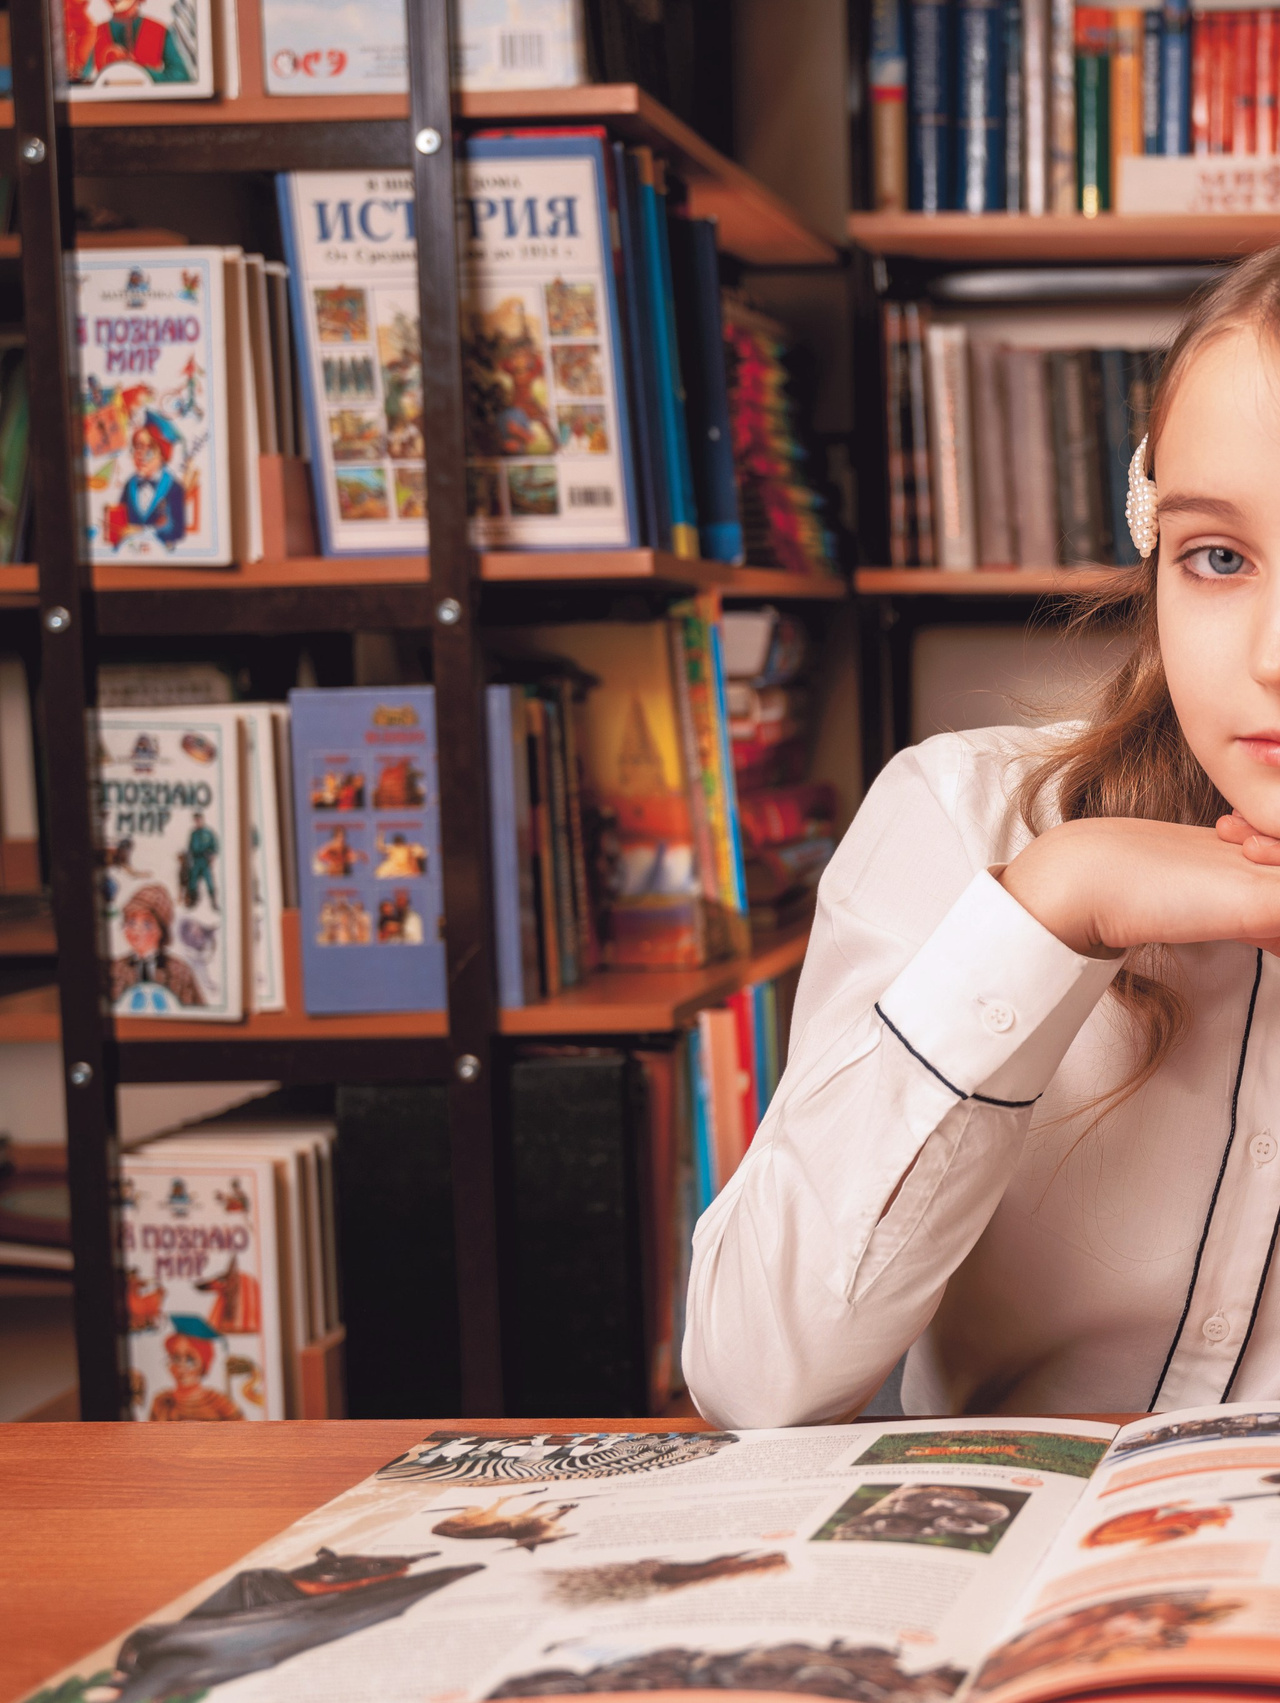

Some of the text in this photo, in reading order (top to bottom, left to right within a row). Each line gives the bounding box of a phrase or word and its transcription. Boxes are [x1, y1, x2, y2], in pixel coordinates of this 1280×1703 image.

[313, 195, 581, 244] ИСТРИЯ
[95, 315, 201, 346] ПОЗНАЮ
[105, 346, 161, 375] МИР
[115, 808, 171, 836] МИР
[155, 1253, 208, 1281] МИР
